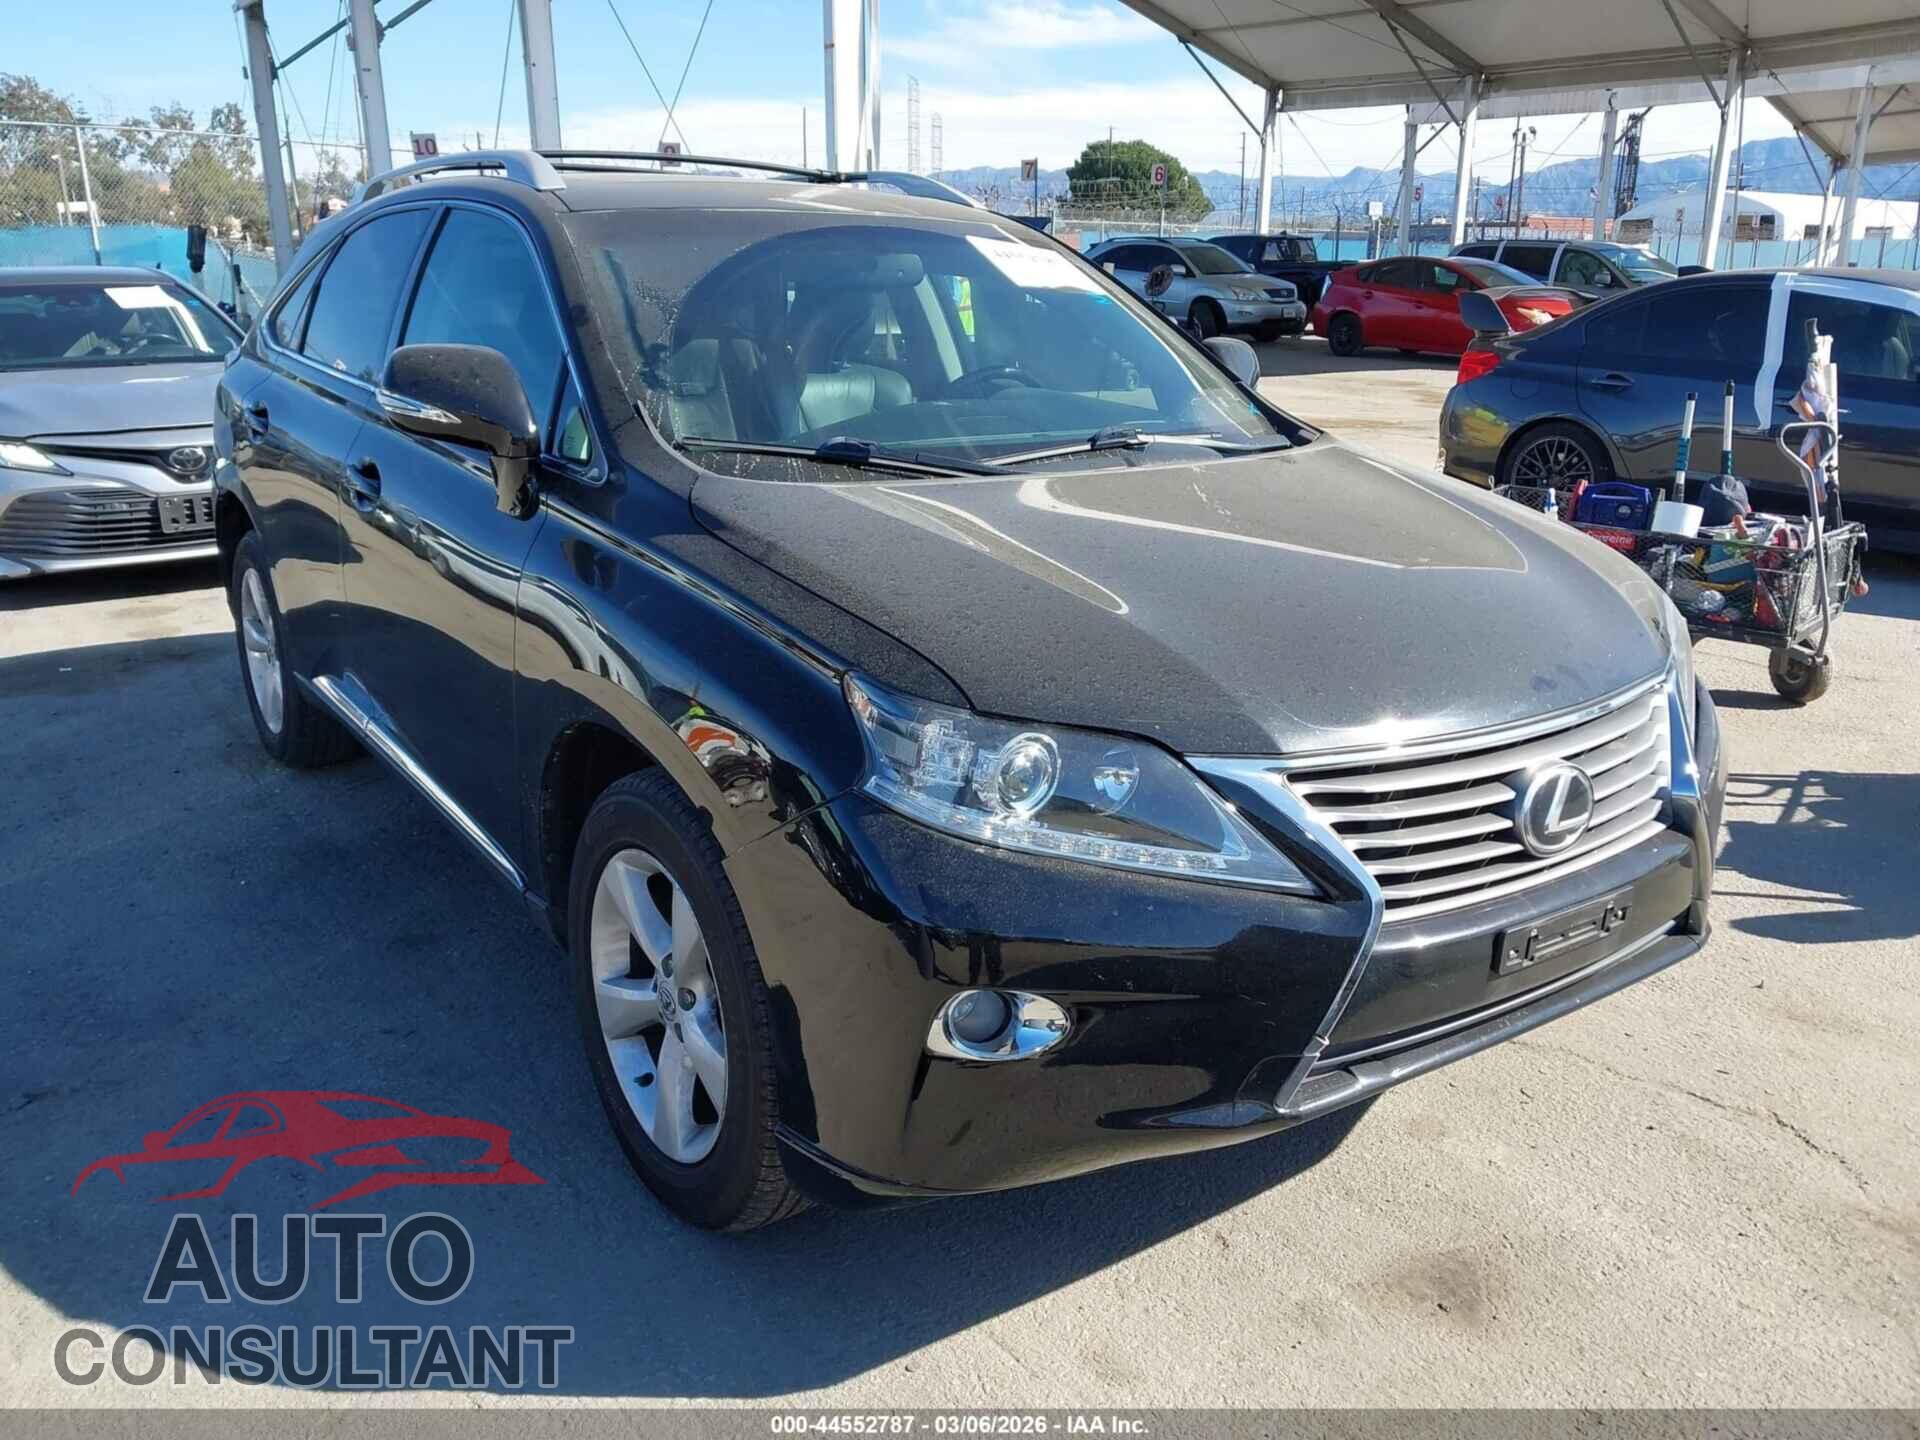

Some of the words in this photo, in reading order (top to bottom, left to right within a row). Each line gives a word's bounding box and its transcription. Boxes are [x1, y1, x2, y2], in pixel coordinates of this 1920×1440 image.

[415, 138, 437, 155] 10
[1024, 161, 1034, 178] 7
[1155, 166, 1164, 182] 6
